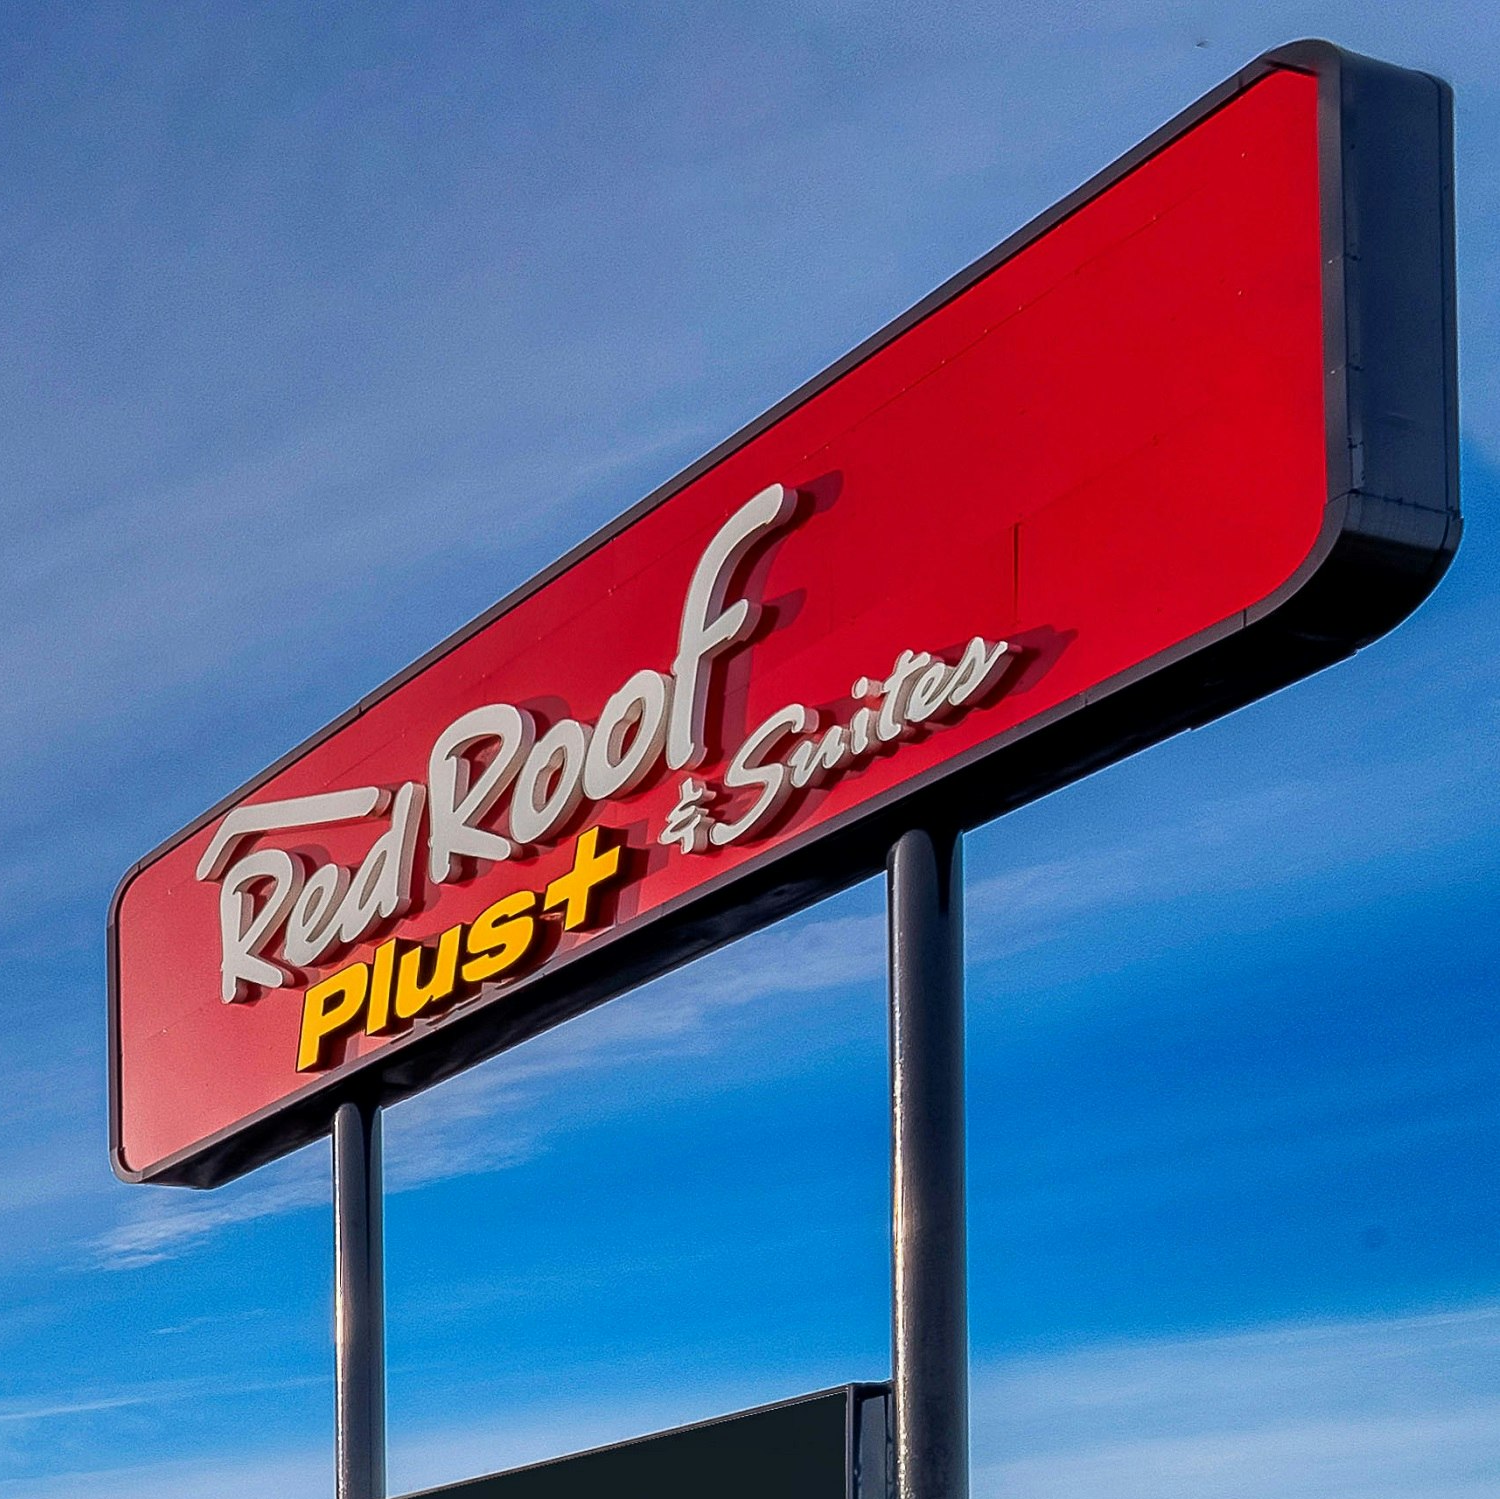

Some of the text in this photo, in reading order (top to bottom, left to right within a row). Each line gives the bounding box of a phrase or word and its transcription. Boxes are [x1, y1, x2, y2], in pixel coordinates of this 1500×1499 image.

[219, 483, 792, 1004] Red Roof
[656, 636, 1012, 854] & Suites
